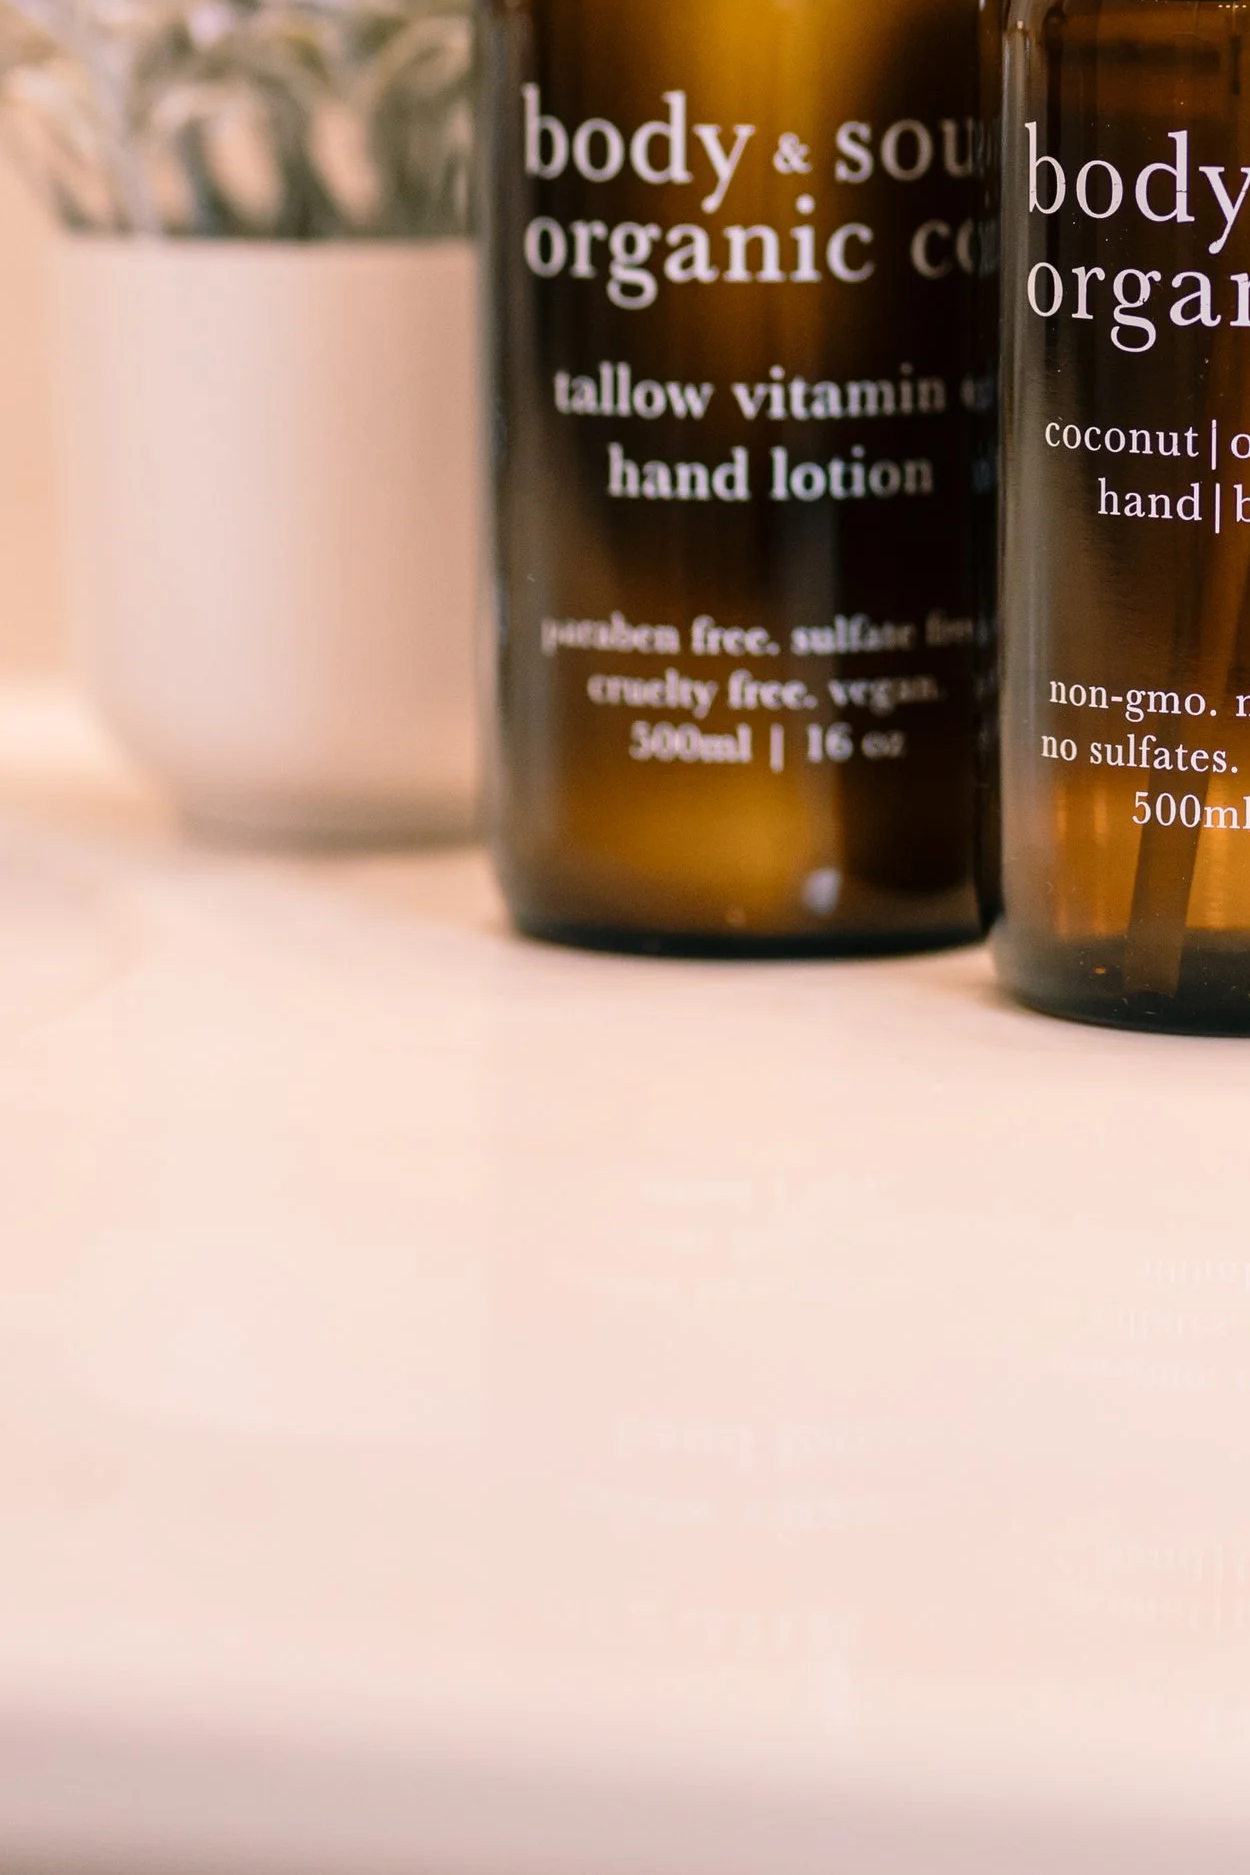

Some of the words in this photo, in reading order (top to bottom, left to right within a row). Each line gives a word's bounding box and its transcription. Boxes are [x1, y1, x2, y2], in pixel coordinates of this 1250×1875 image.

[522, 82, 755, 213] body
[774, 133, 810, 173] &
[834, 118, 994, 182] sou
[523, 194, 875, 310] organic
[553, 361, 714, 419] tallow
[732, 365, 946, 420] vitamin
[1045, 423, 1199, 457] coconut
[607, 442, 750, 501] hand
[770, 445, 933, 501] lotion
[1098, 477, 1202, 520] hand
[691, 615, 780, 656] free.
[587, 667, 718, 719] cruelty
[728, 669, 819, 710] free.
[1050, 681, 1216, 722] non-gmo.
[629, 721, 753, 765] 500ml
[806, 723, 854, 764] 16
[1041, 736, 1077, 761] no
[1090, 734, 1238, 773] sulfates.
